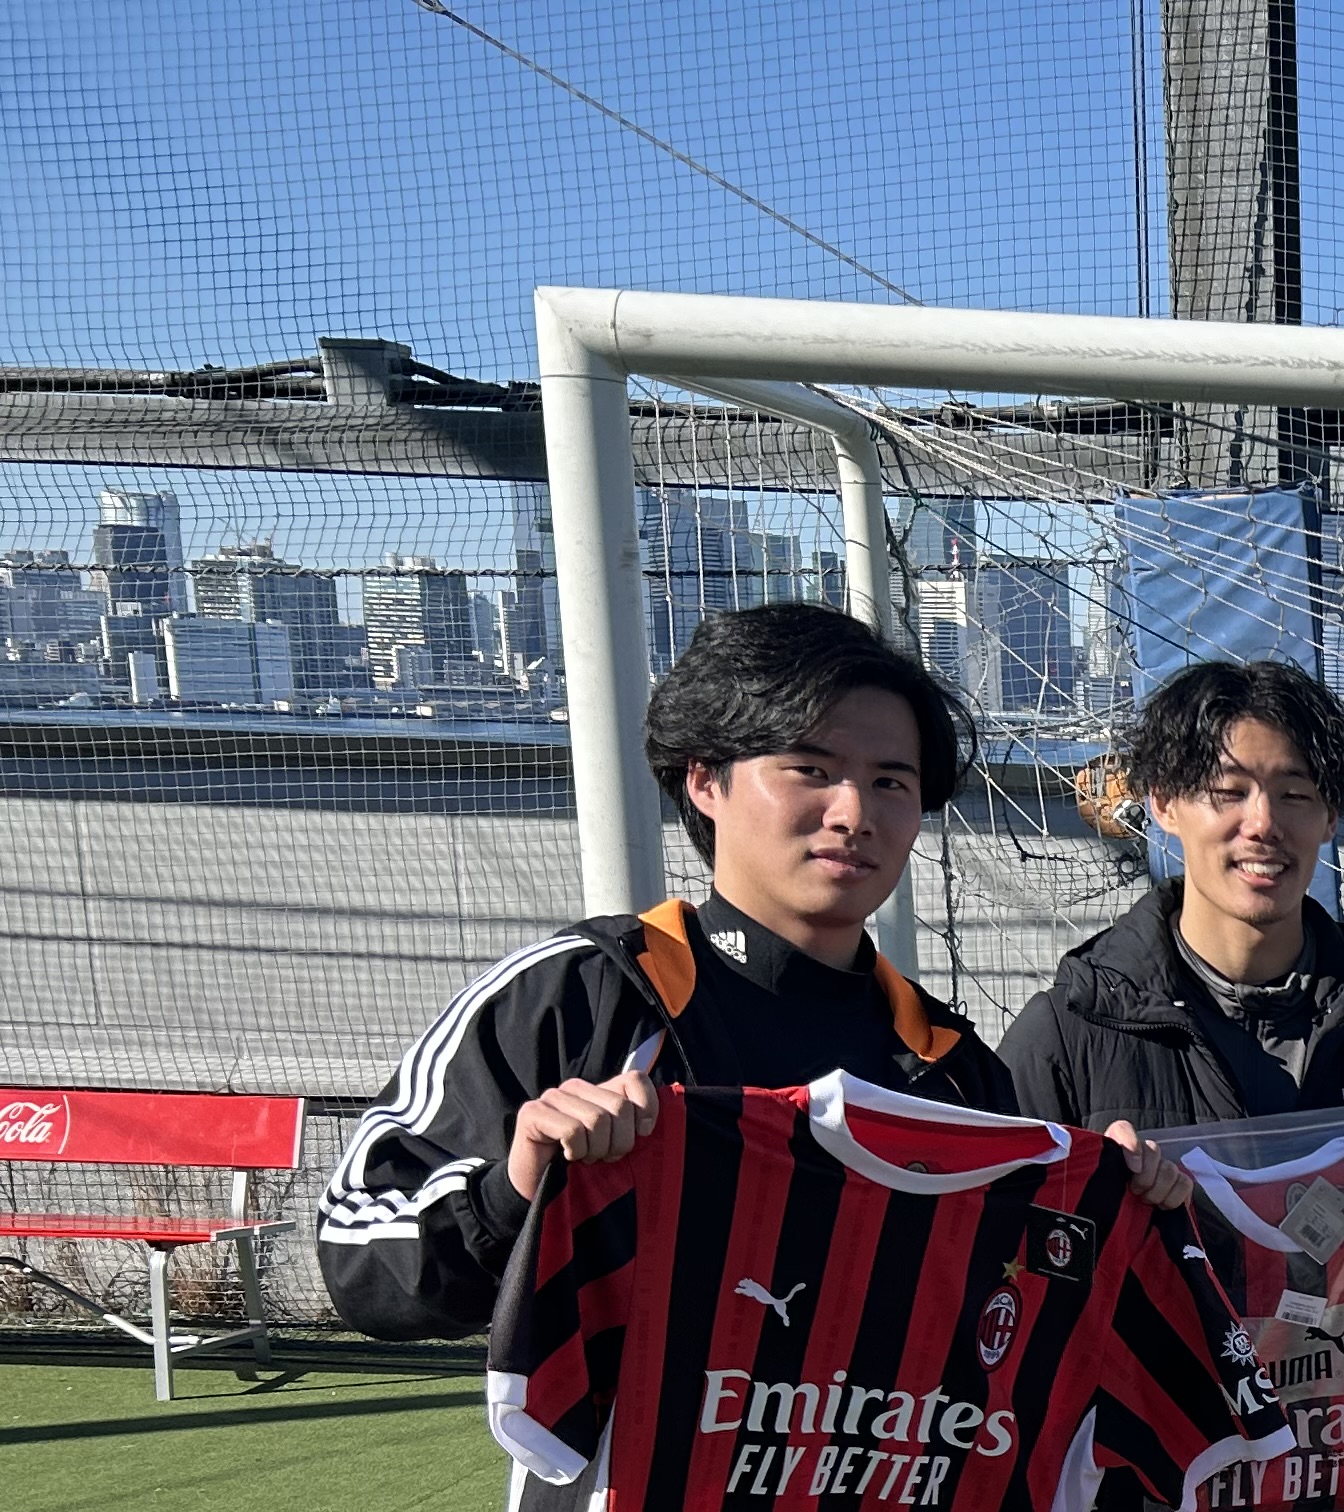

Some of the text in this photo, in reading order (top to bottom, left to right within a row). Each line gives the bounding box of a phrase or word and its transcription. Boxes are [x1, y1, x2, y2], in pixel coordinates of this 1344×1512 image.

[1218, 1366, 1281, 1417] MS
[1265, 1350, 1333, 1389] UMA
[700, 1369, 1016, 1457] Emirates
[726, 1444, 951, 1506] FLY BETTER
[1211, 1461, 1269, 1508] FLY
